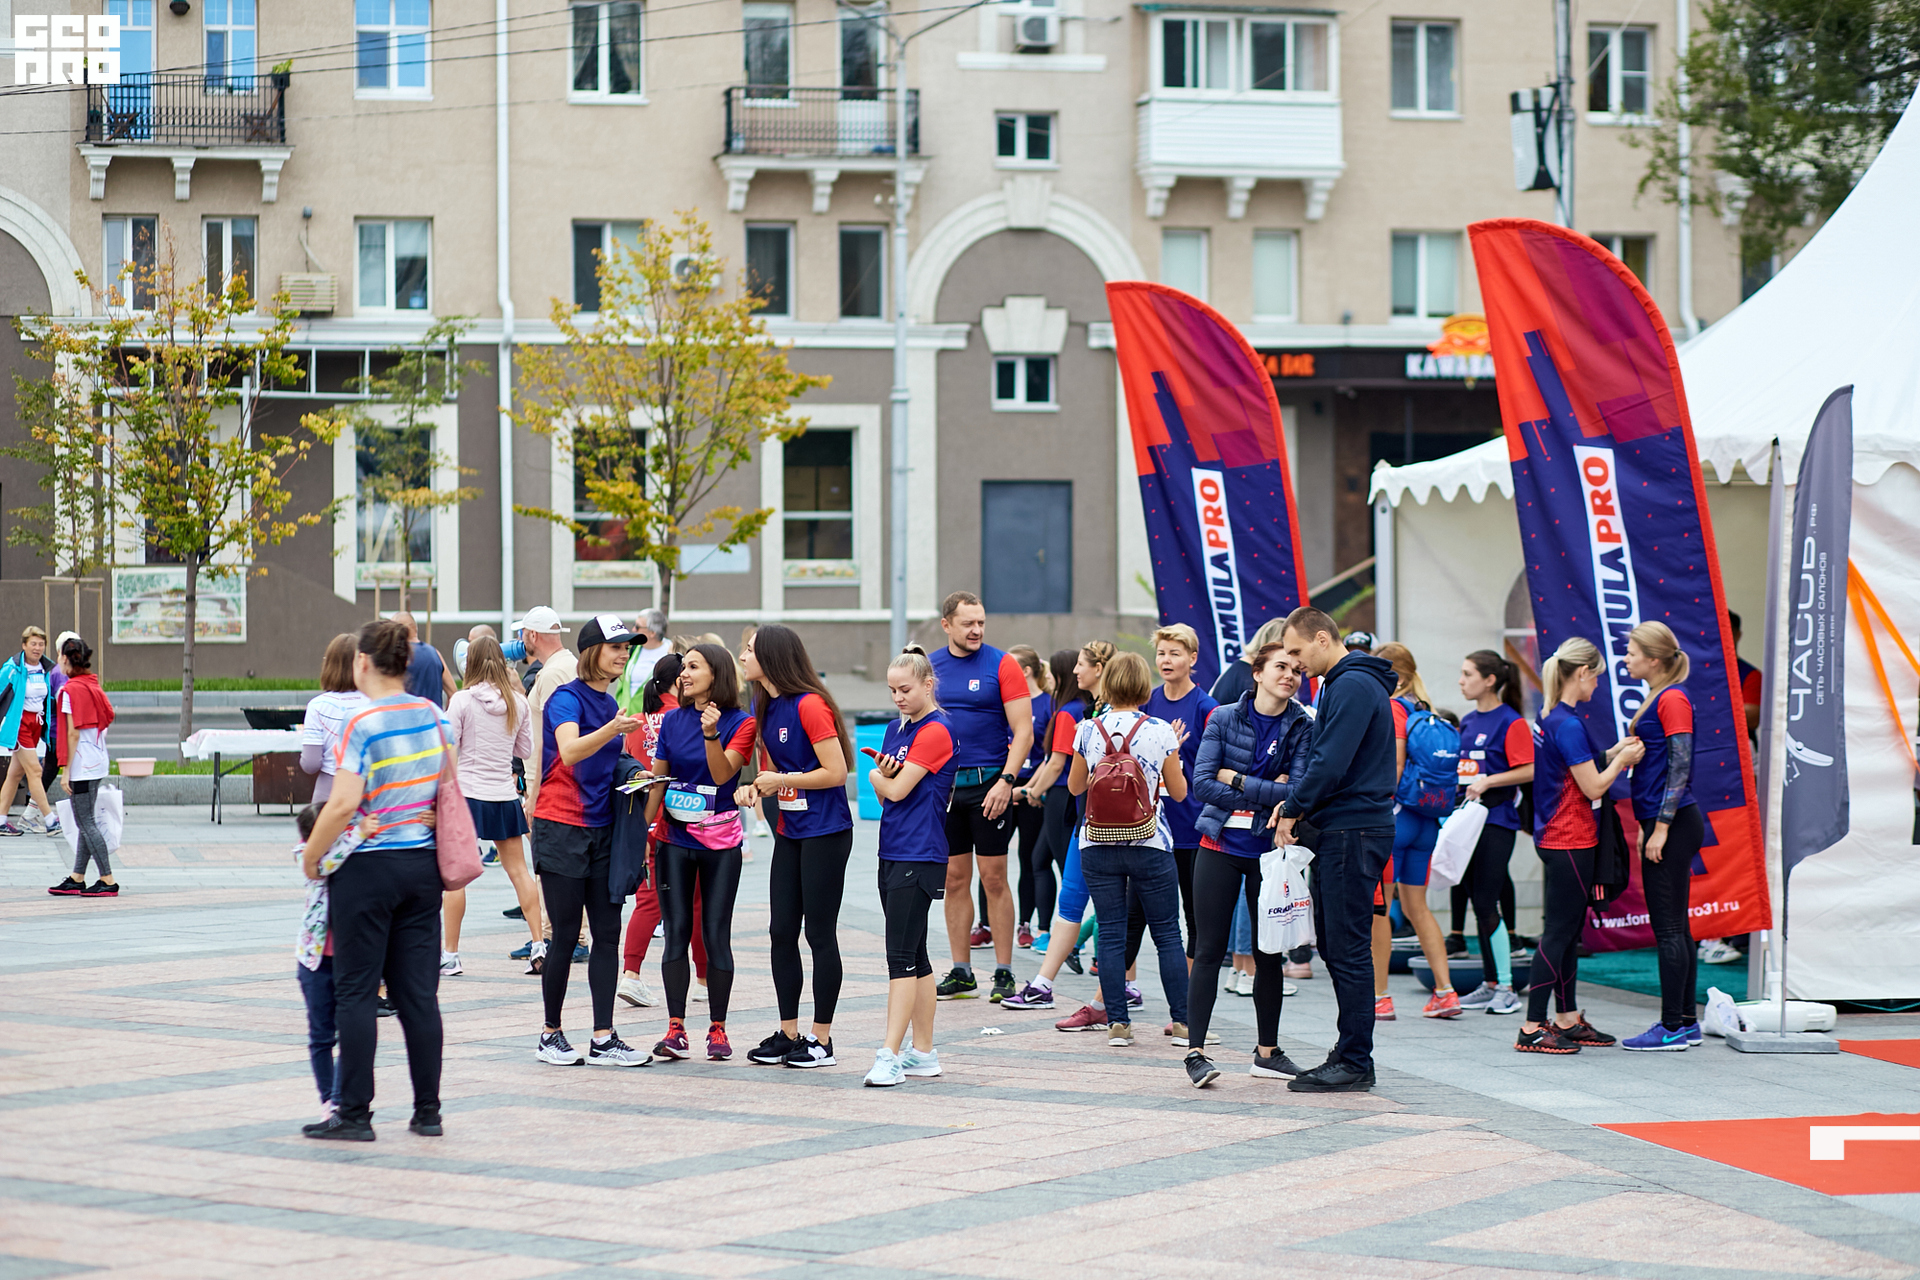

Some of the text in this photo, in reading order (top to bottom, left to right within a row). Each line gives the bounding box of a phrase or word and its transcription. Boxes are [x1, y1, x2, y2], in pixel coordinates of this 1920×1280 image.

[1816, 552, 1828, 705] СЕТЬ ЧАСОВЫХ САЛОНОВ
[671, 793, 702, 810] 1209
